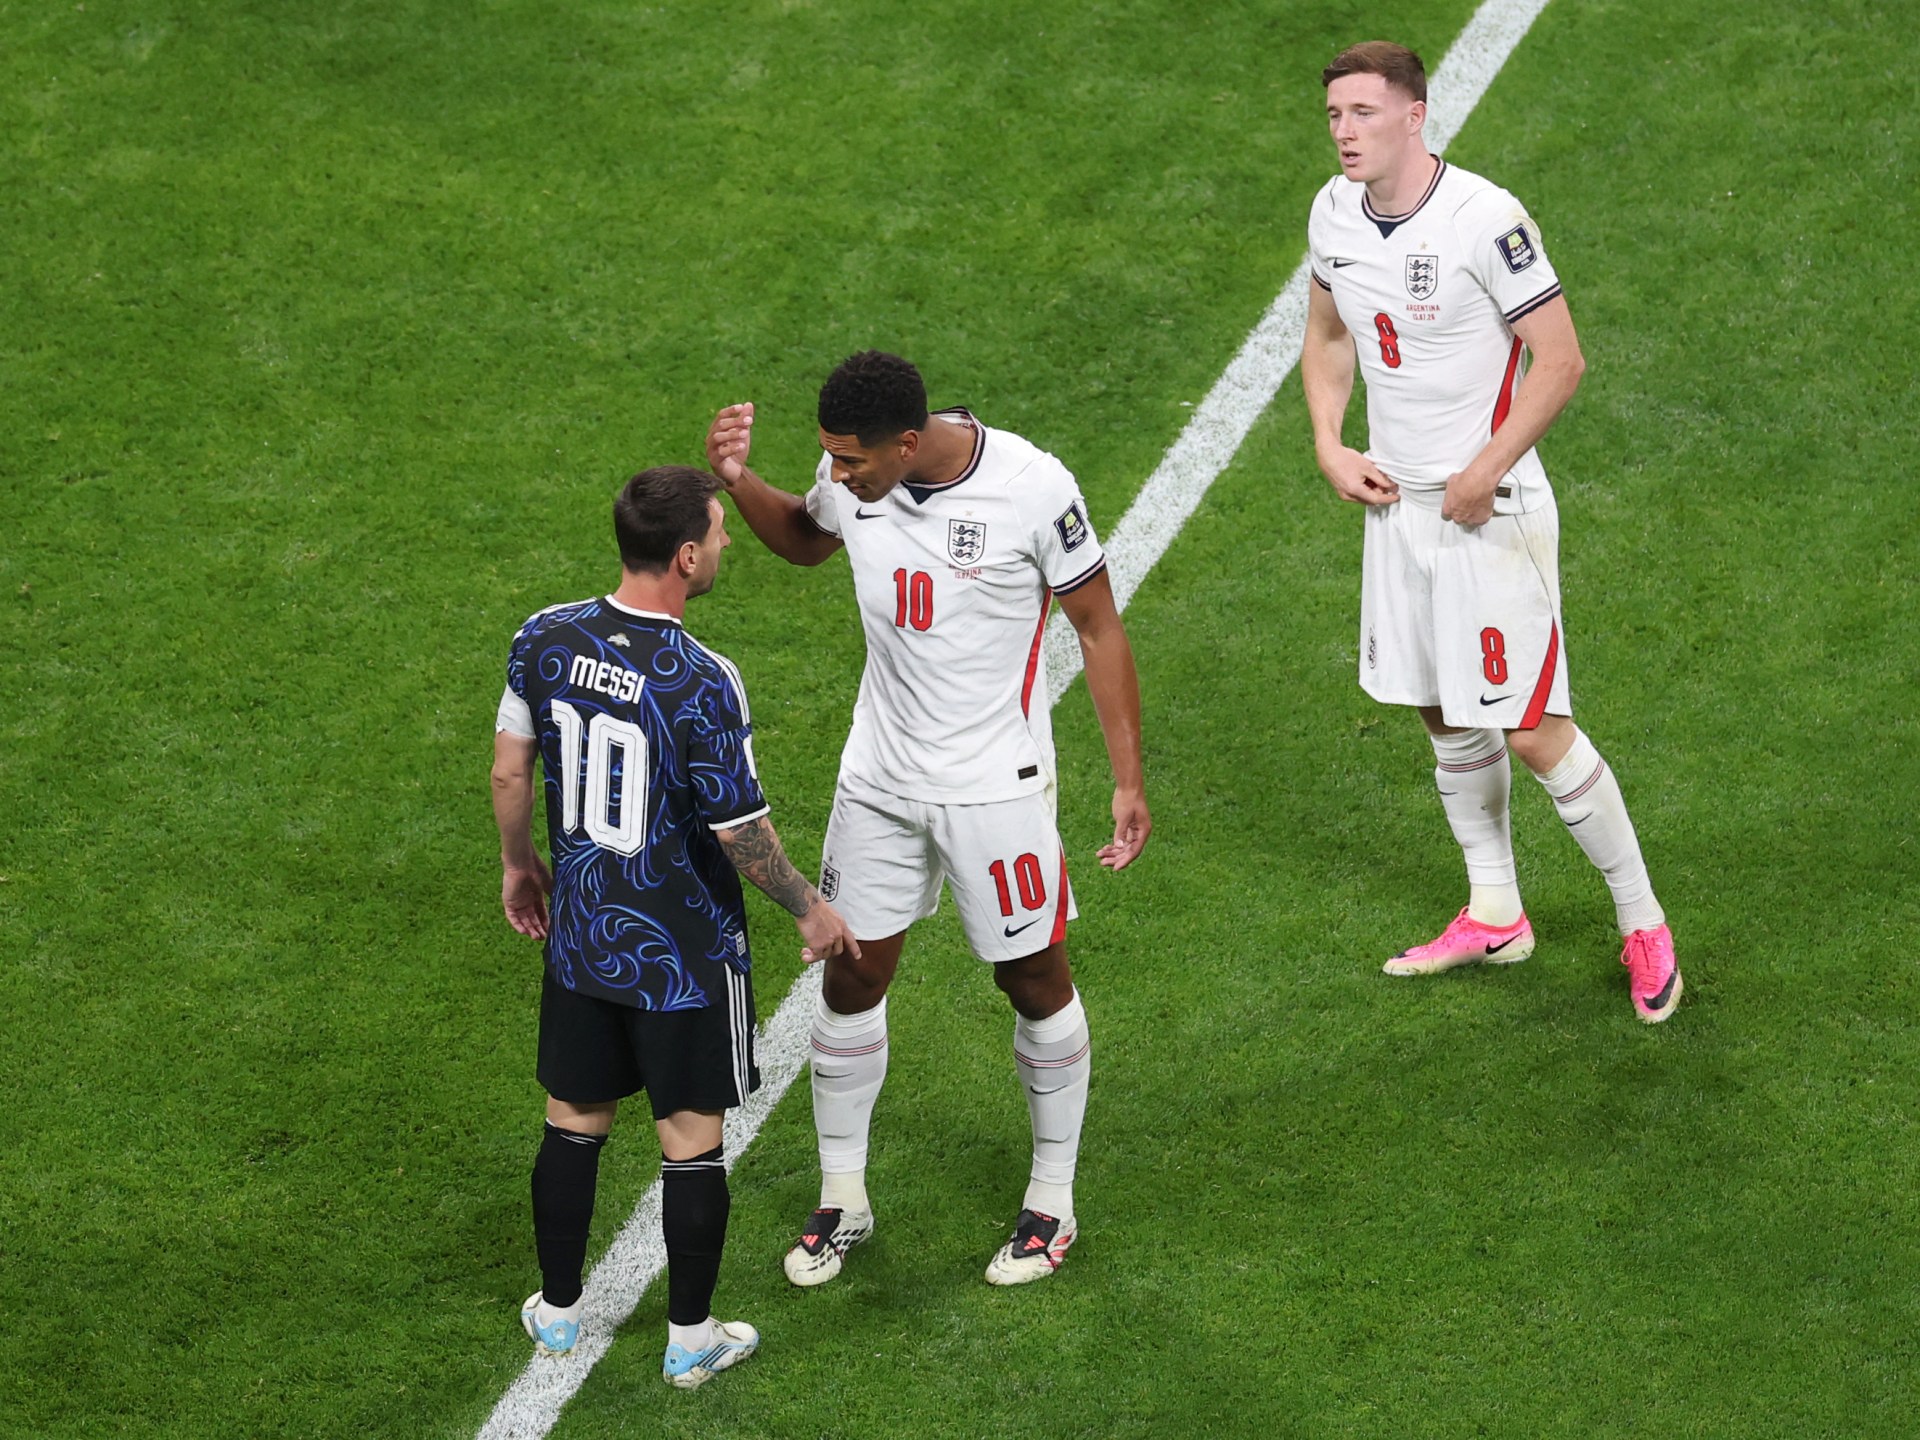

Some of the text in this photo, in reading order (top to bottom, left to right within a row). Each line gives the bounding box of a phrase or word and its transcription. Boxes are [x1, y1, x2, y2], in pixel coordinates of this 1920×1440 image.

[1406, 304, 1440, 312] ARGENTINA
[1374, 312, 1401, 369] 8
[893, 567, 934, 632] 10
[569, 654, 646, 705] MESSI
[1480, 626, 1508, 685] 8
[550, 698, 650, 858] 10
[989, 852, 1047, 916] 10
